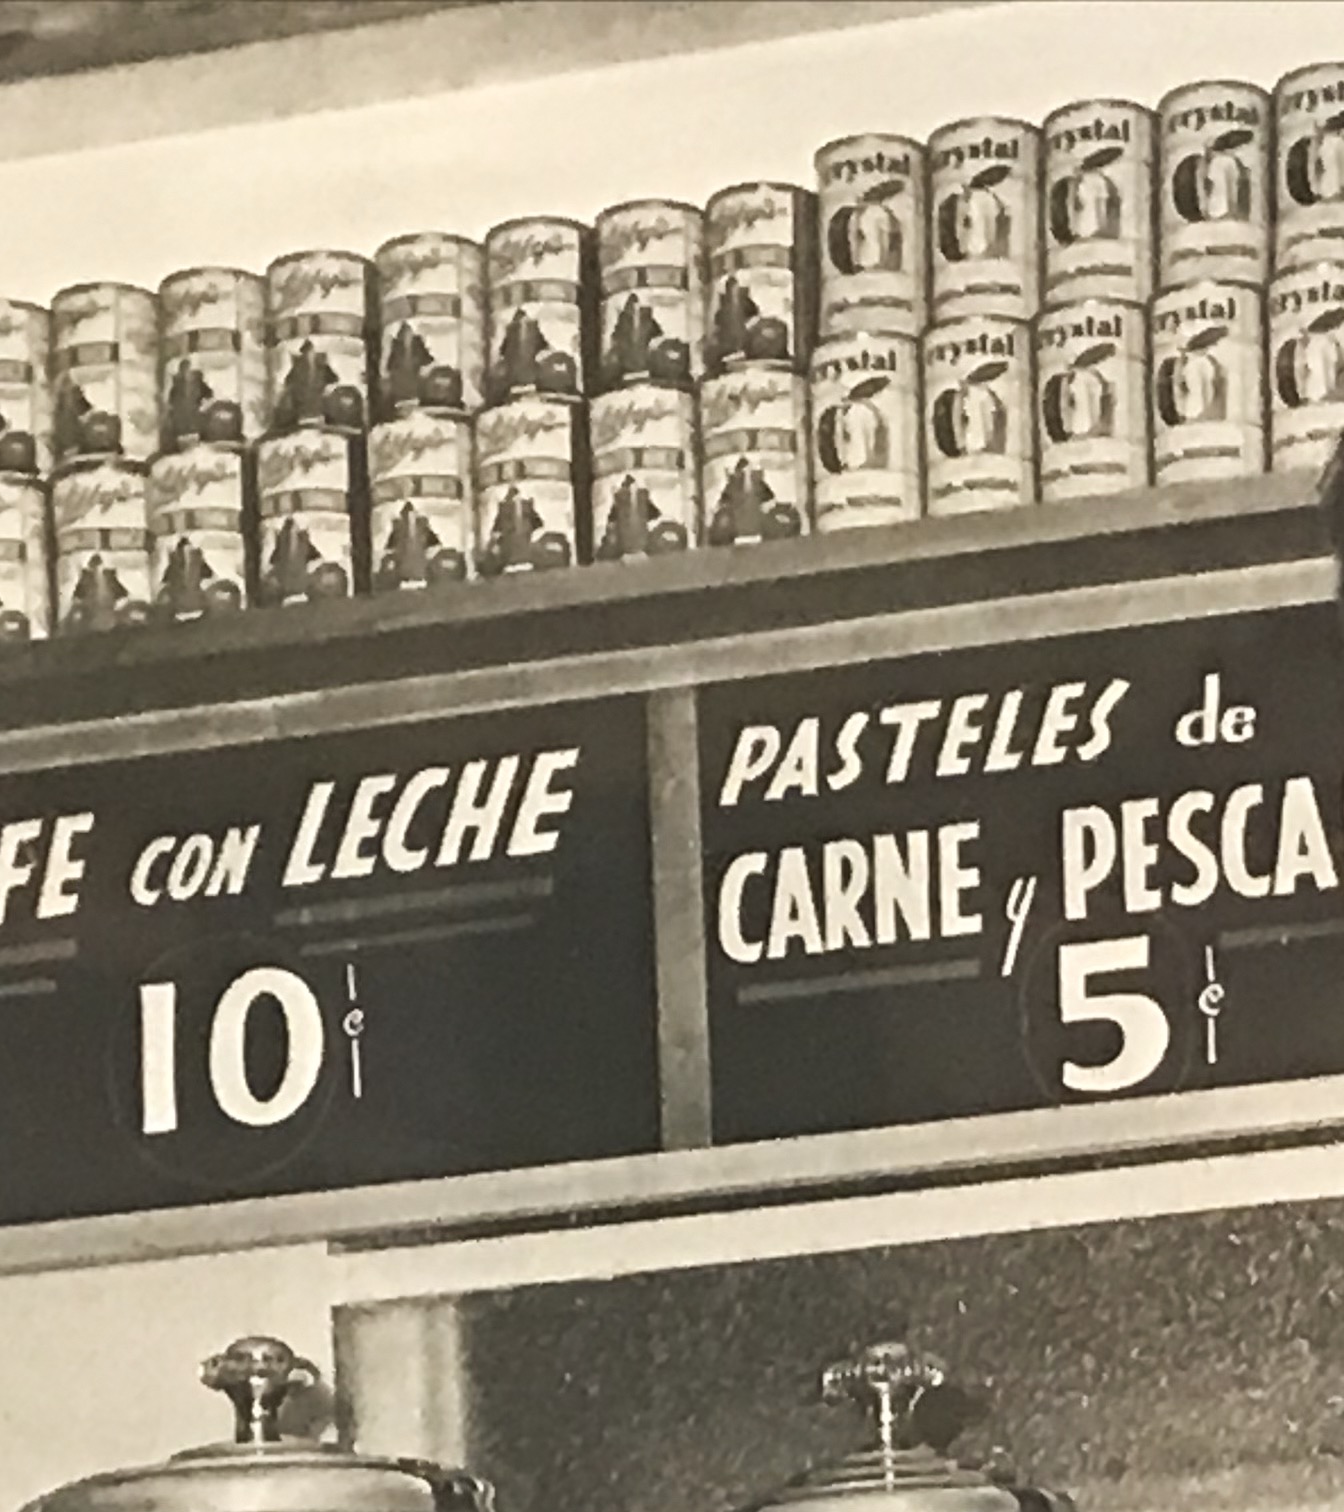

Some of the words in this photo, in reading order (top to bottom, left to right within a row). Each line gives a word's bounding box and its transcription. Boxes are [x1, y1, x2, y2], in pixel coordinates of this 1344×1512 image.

[719, 677, 1132, 807] PASTELES
[1175, 672, 1257, 747] de
[282, 747, 582, 888] LECHE
[717, 819, 984, 965] CARNE
[1000, 875, 1039, 978] y
